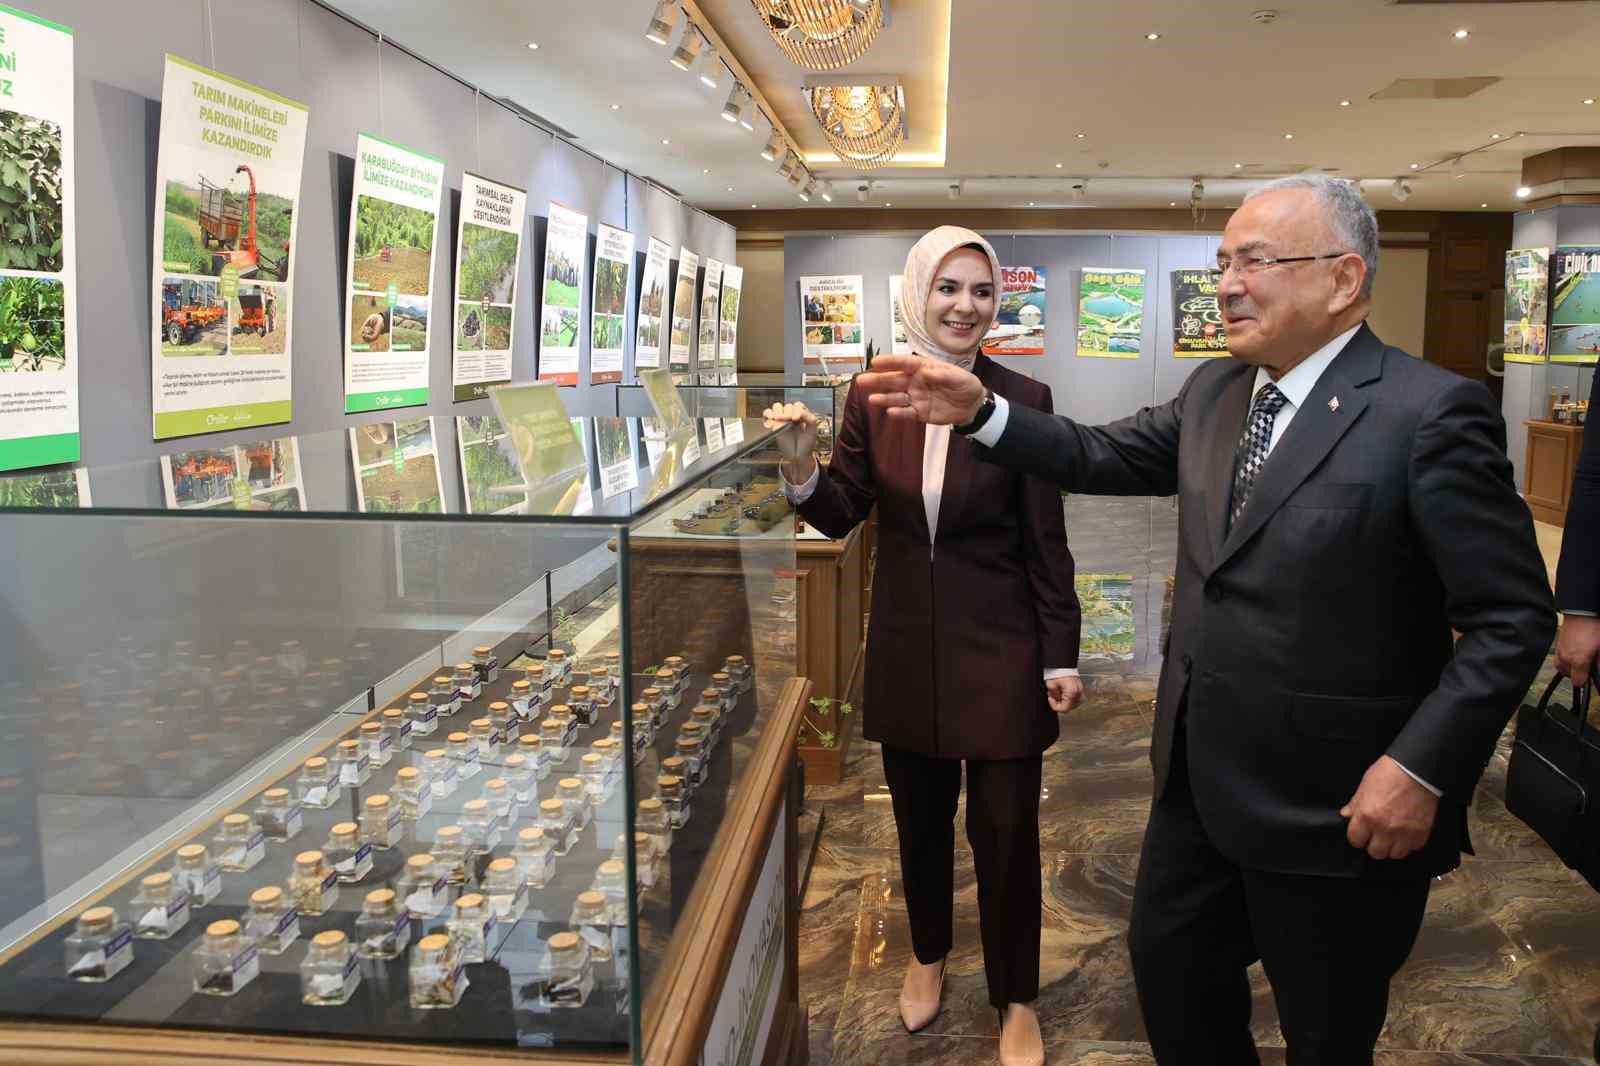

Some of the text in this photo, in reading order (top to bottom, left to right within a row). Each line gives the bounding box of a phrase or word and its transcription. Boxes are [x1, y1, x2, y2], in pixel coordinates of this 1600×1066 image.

[192, 81, 288, 126] TARIM MAKİNELERİ
[199, 105, 278, 143] PARKINI İLİMİZE
